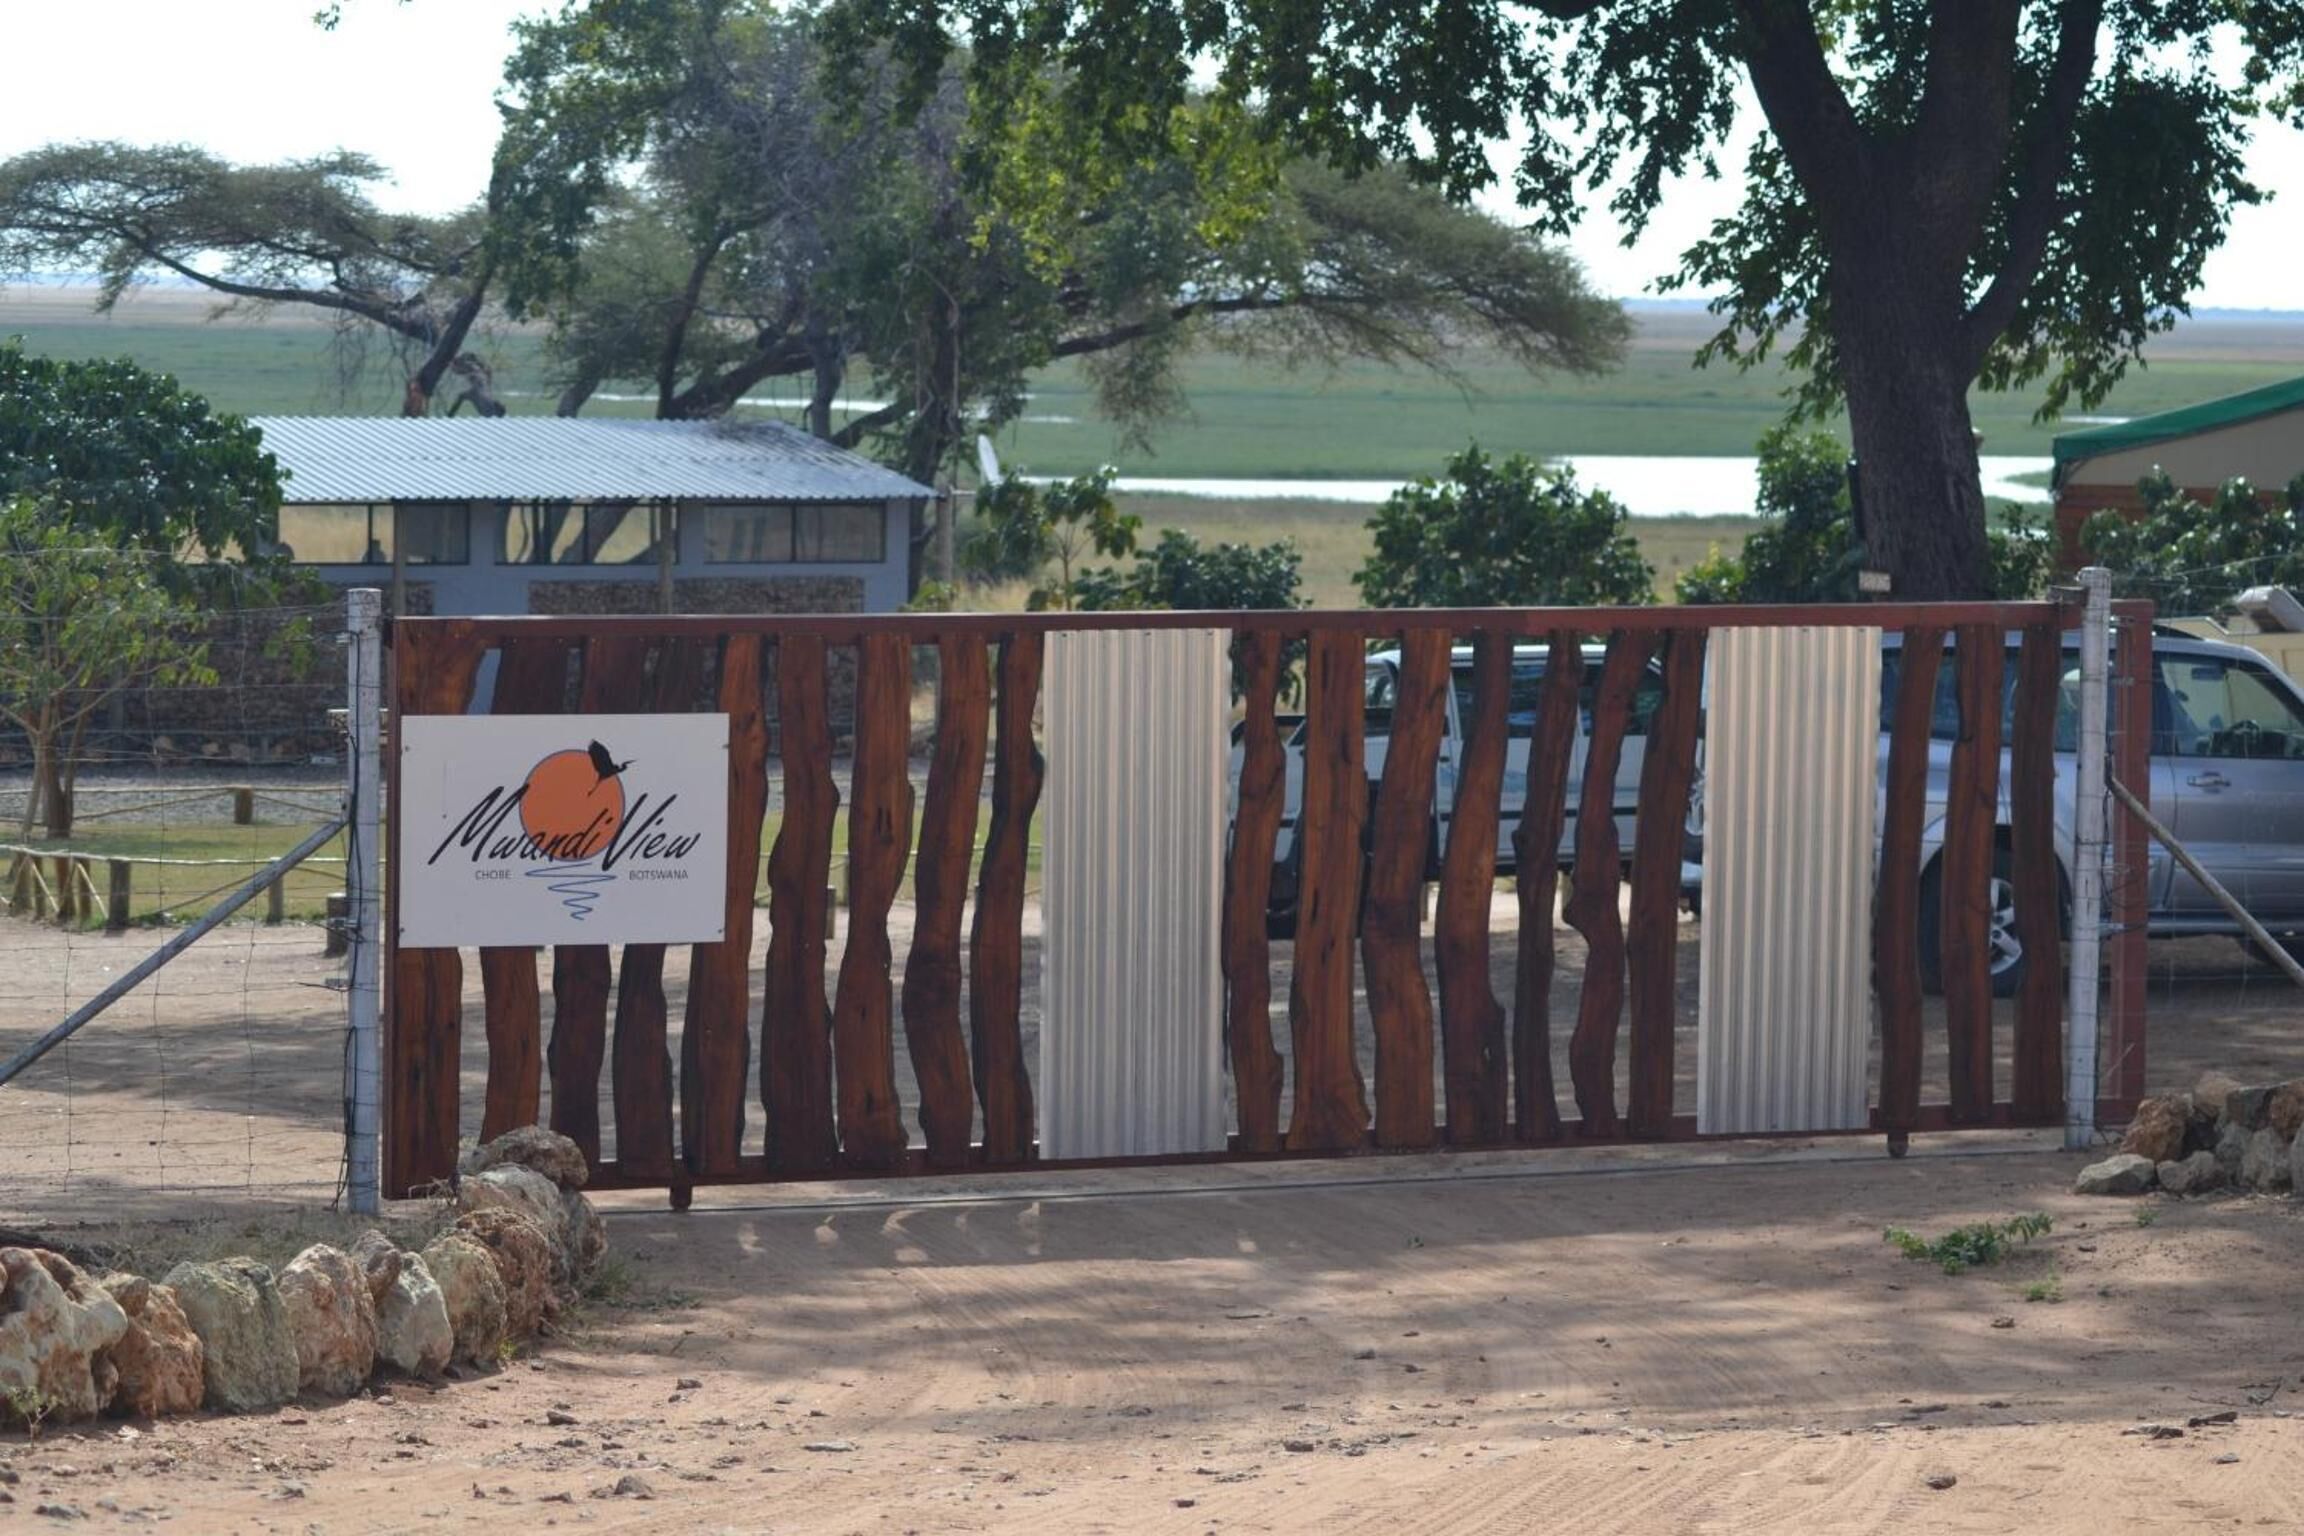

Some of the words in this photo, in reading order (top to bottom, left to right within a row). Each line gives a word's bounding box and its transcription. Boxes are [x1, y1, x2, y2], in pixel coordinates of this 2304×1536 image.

[428, 784, 613, 865] Mwandi
[602, 793, 701, 871] View
[475, 869, 512, 881] CHOBE
[628, 869, 689, 881] BOTSWANA
